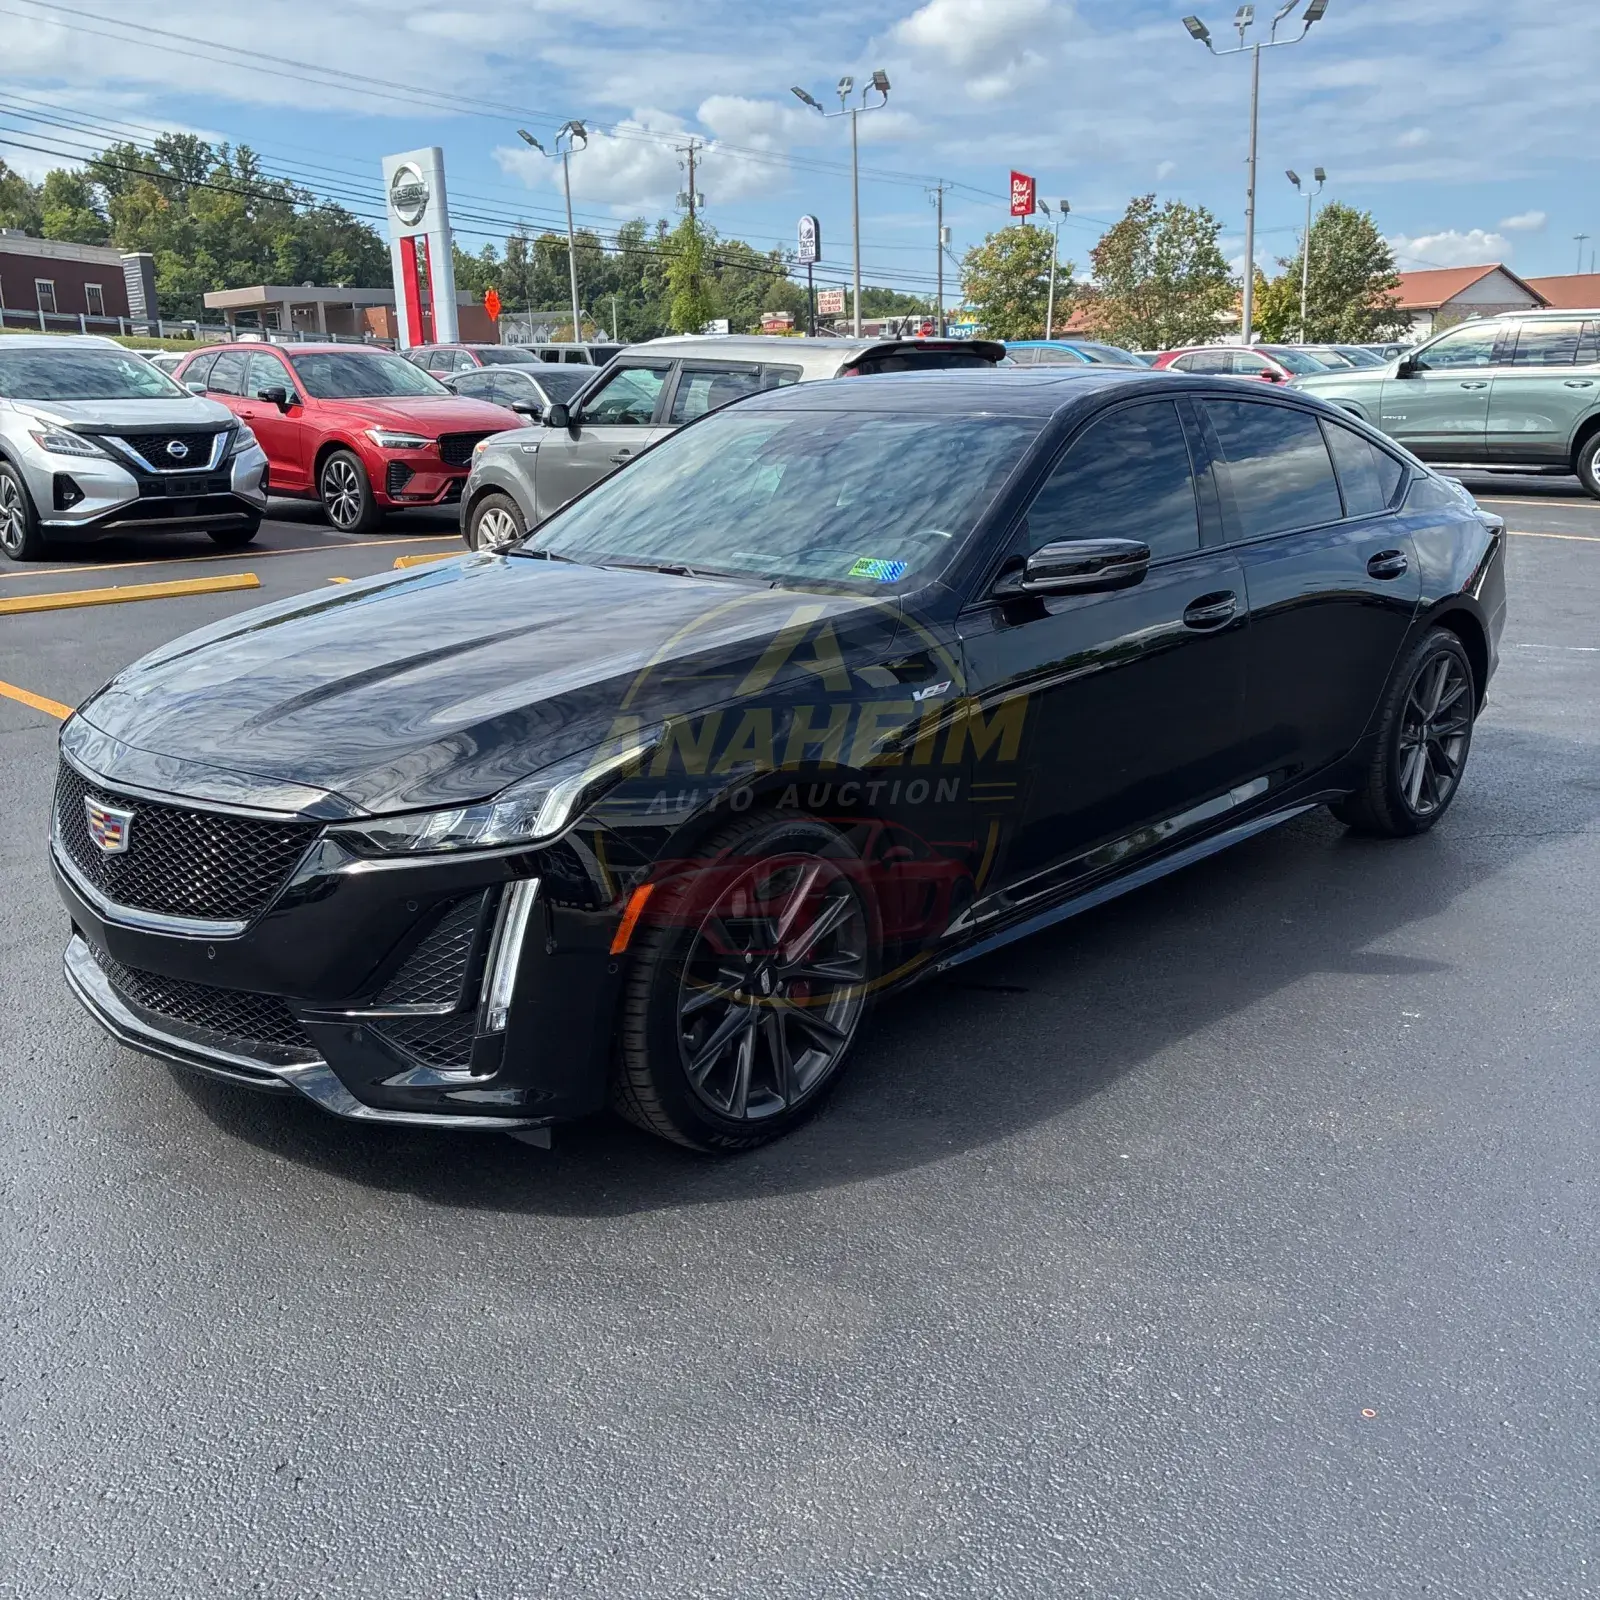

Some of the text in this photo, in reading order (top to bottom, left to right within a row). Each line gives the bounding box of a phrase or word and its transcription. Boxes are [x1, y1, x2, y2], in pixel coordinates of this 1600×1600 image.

[1013, 179, 1028, 192] Red
[1012, 189, 1031, 206] Roof
[799, 240, 815, 248] TACO
[800, 248, 815, 257] BELL
[948, 327, 971, 337] Days
